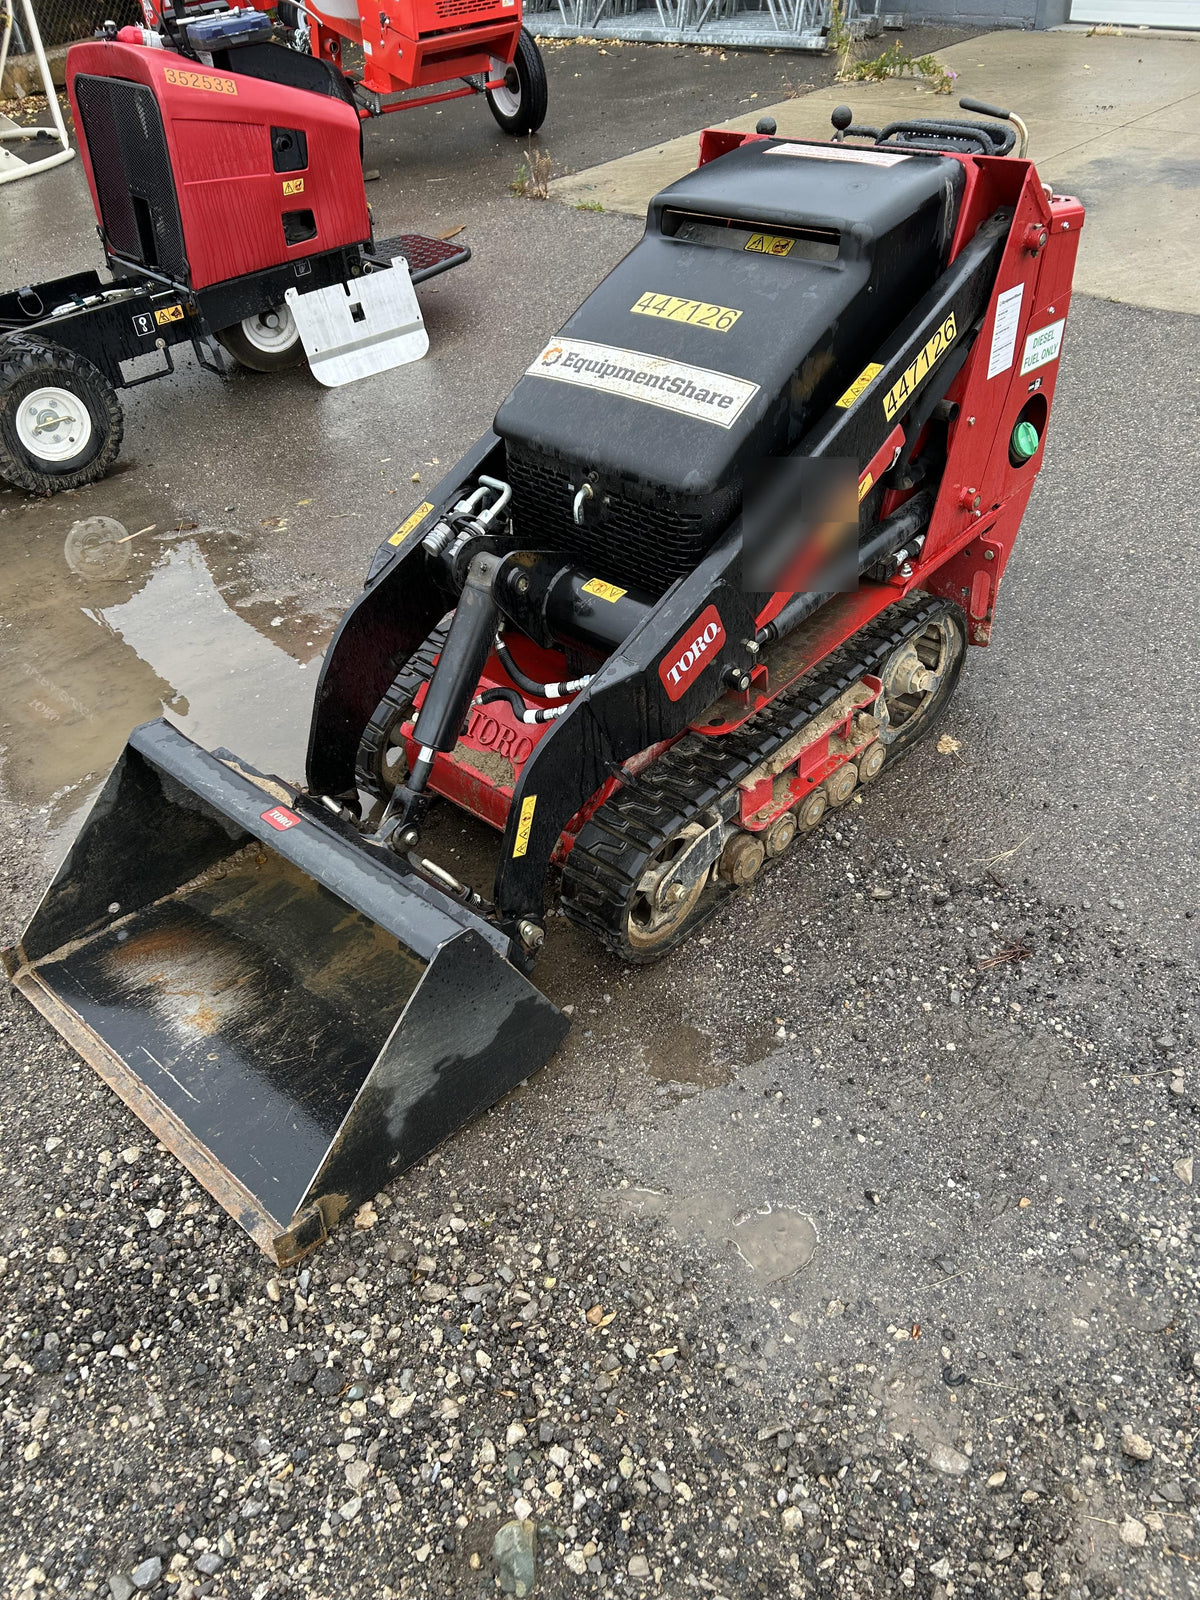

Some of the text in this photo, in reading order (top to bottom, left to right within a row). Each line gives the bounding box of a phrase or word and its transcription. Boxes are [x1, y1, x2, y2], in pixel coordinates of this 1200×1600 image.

[166, 69, 236, 94] 352533
[637, 294, 738, 330] 447126
[1023, 341, 1059, 369] FUEL ONLY
[1032, 329, 1055, 349] DIESEL
[561, 352, 734, 409] EquipmentShare
[887, 316, 955, 414] 447126
[666, 622, 719, 686] TORO
[466, 706, 534, 765] TORO
[268, 809, 294, 828] TORO
